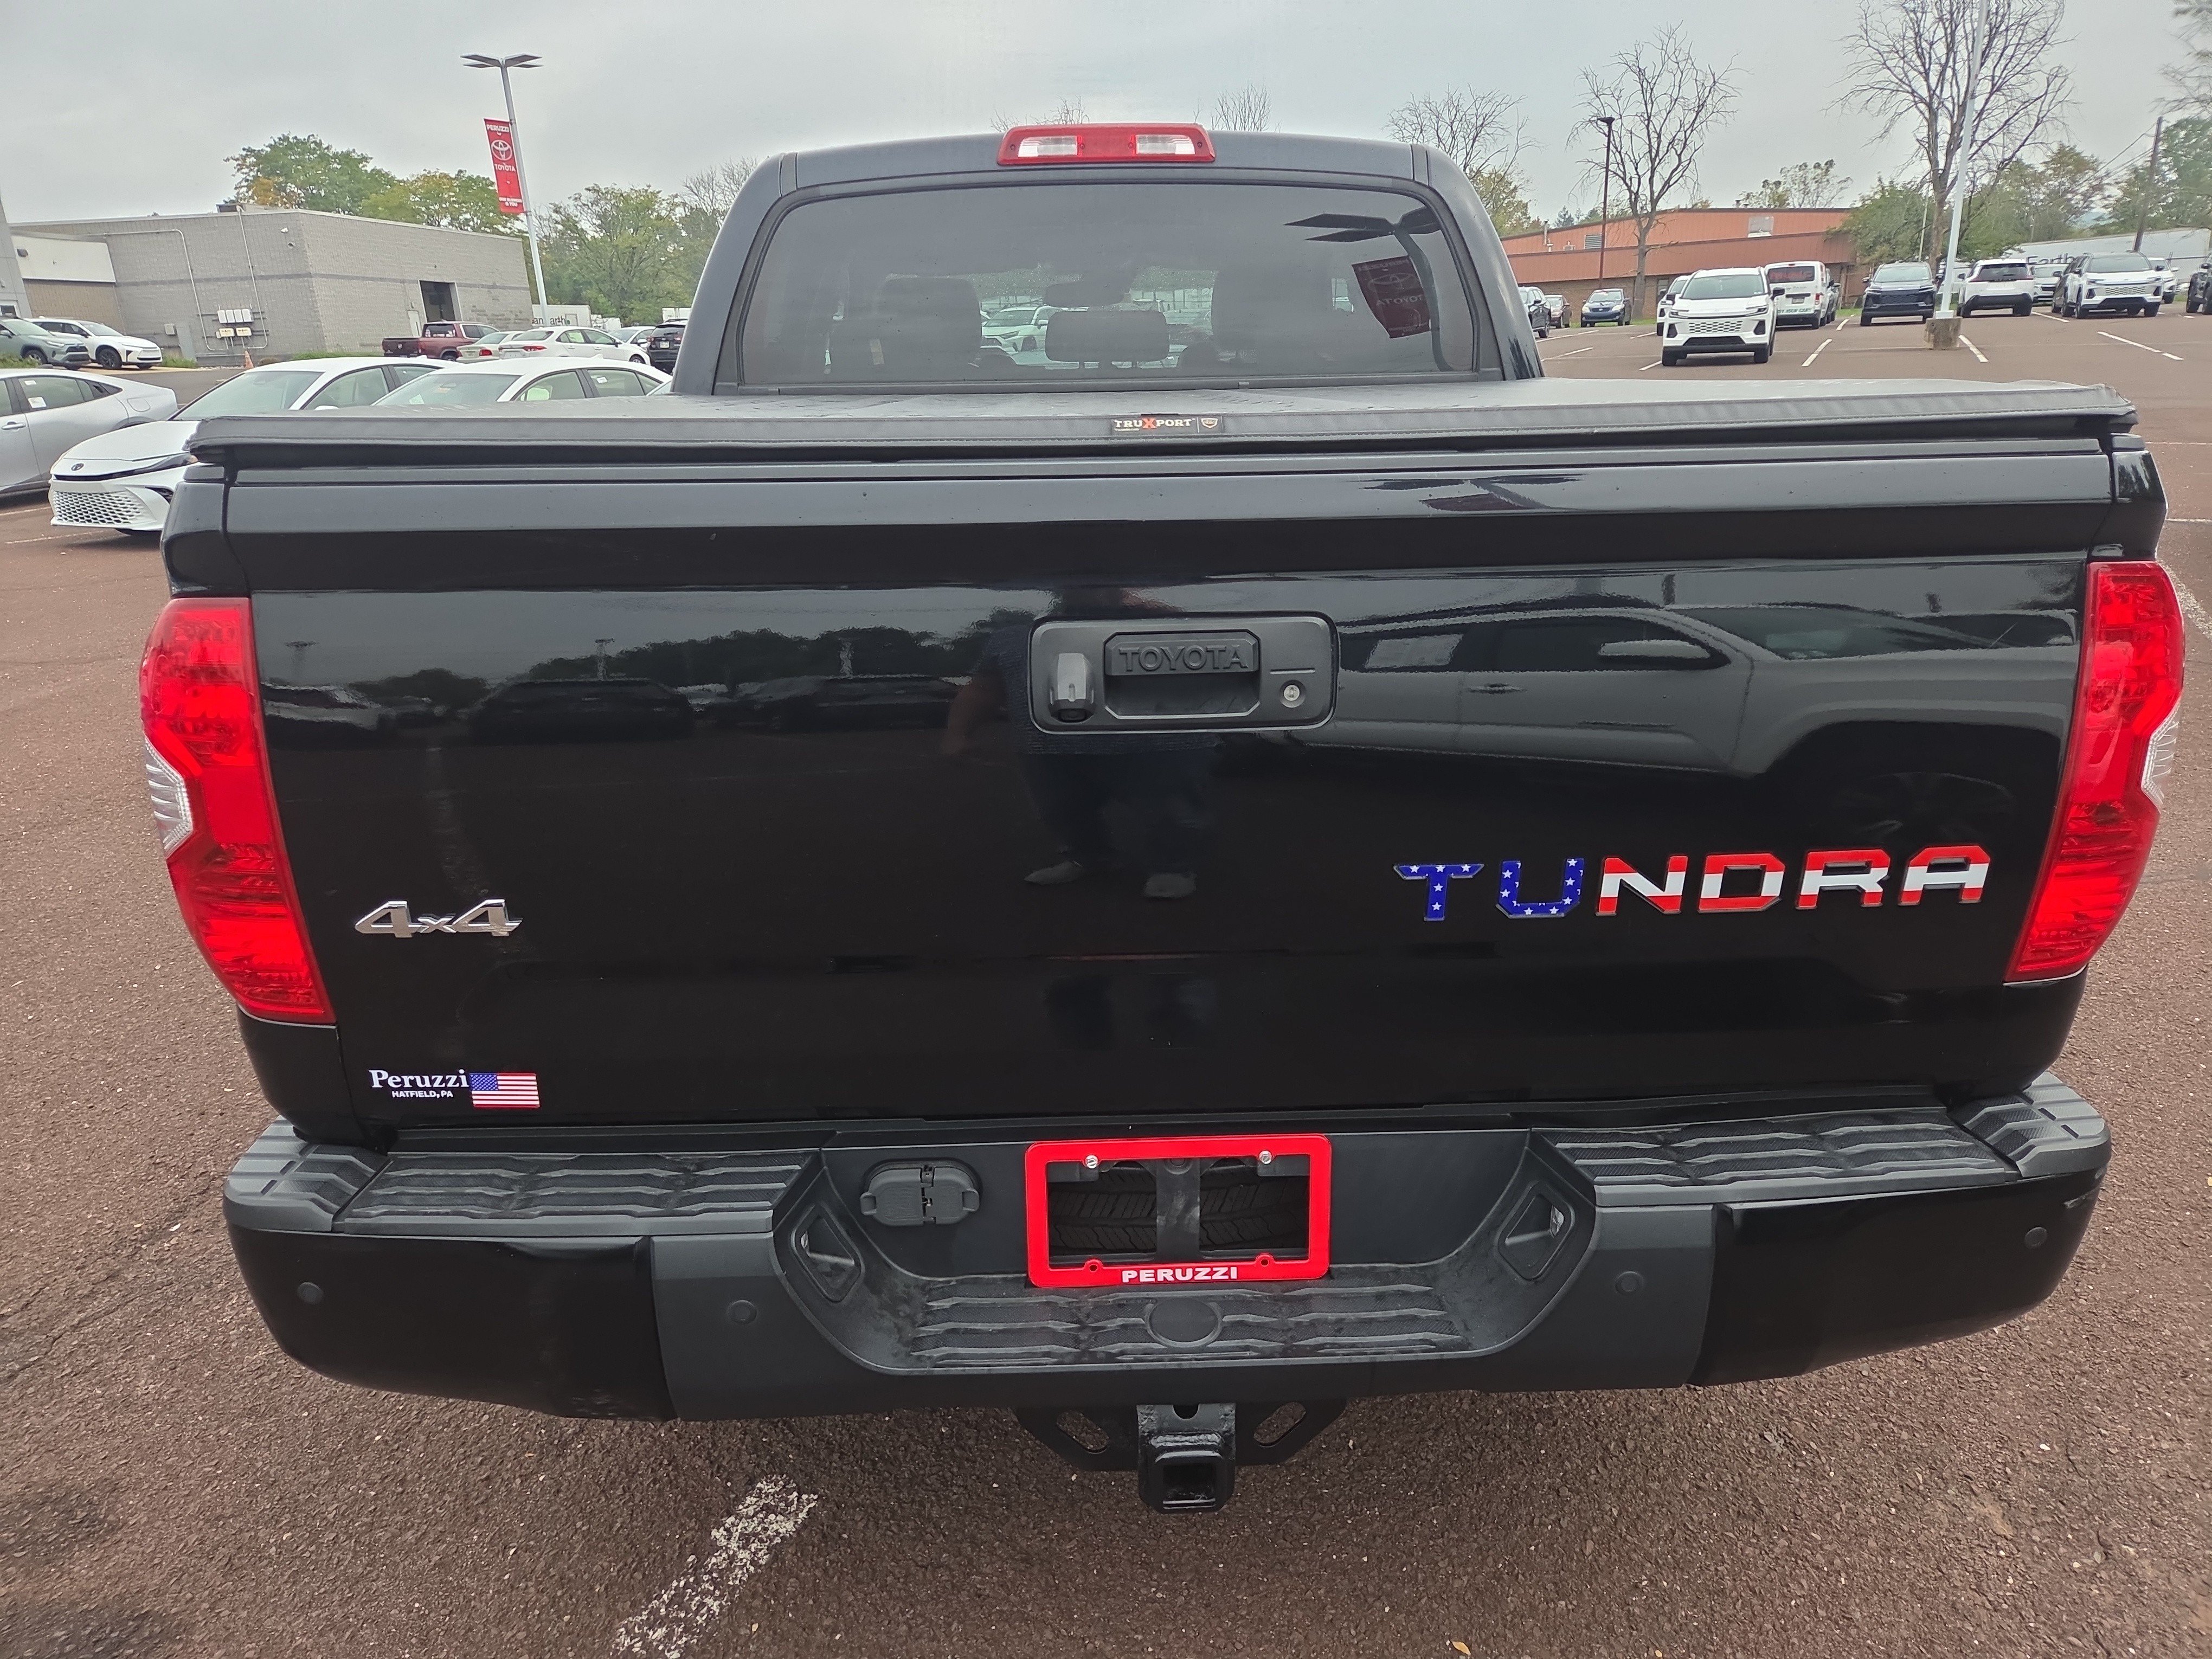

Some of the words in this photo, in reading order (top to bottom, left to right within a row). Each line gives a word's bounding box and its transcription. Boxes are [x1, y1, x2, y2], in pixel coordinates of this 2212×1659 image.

[486, 124, 510, 133] PERUZZI
[494, 164, 516, 172] TOYOTA
[550, 316, 566, 325] arth
[1114, 418, 1192, 429] TRUXPORT
[1118, 644, 1248, 672] TOYOTA
[1393, 845, 1991, 921] TUNDRA
[368, 1069, 470, 1088] Peruzzi
[1122, 1266, 1238, 1283] PERUZZI
